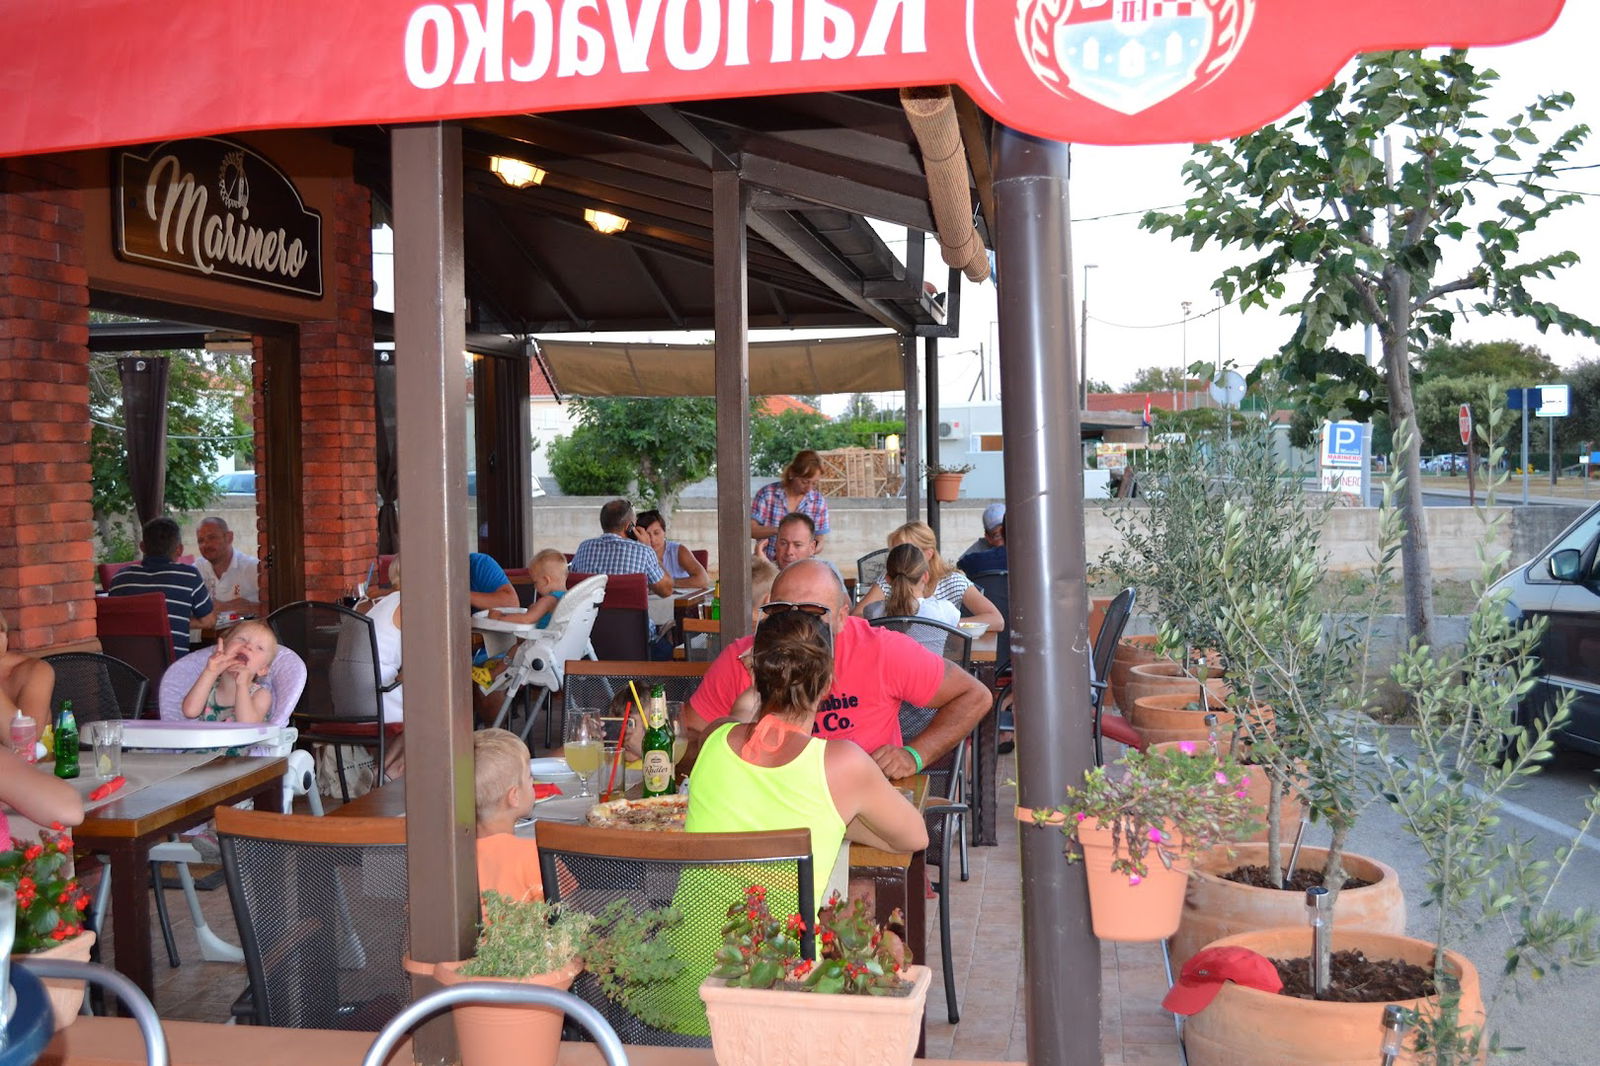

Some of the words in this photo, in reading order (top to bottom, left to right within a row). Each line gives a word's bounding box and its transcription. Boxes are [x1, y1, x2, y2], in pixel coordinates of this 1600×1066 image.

[146, 155, 308, 274] Marinero
[1335, 427, 1355, 453] P
[823, 712, 854, 731] Co.
